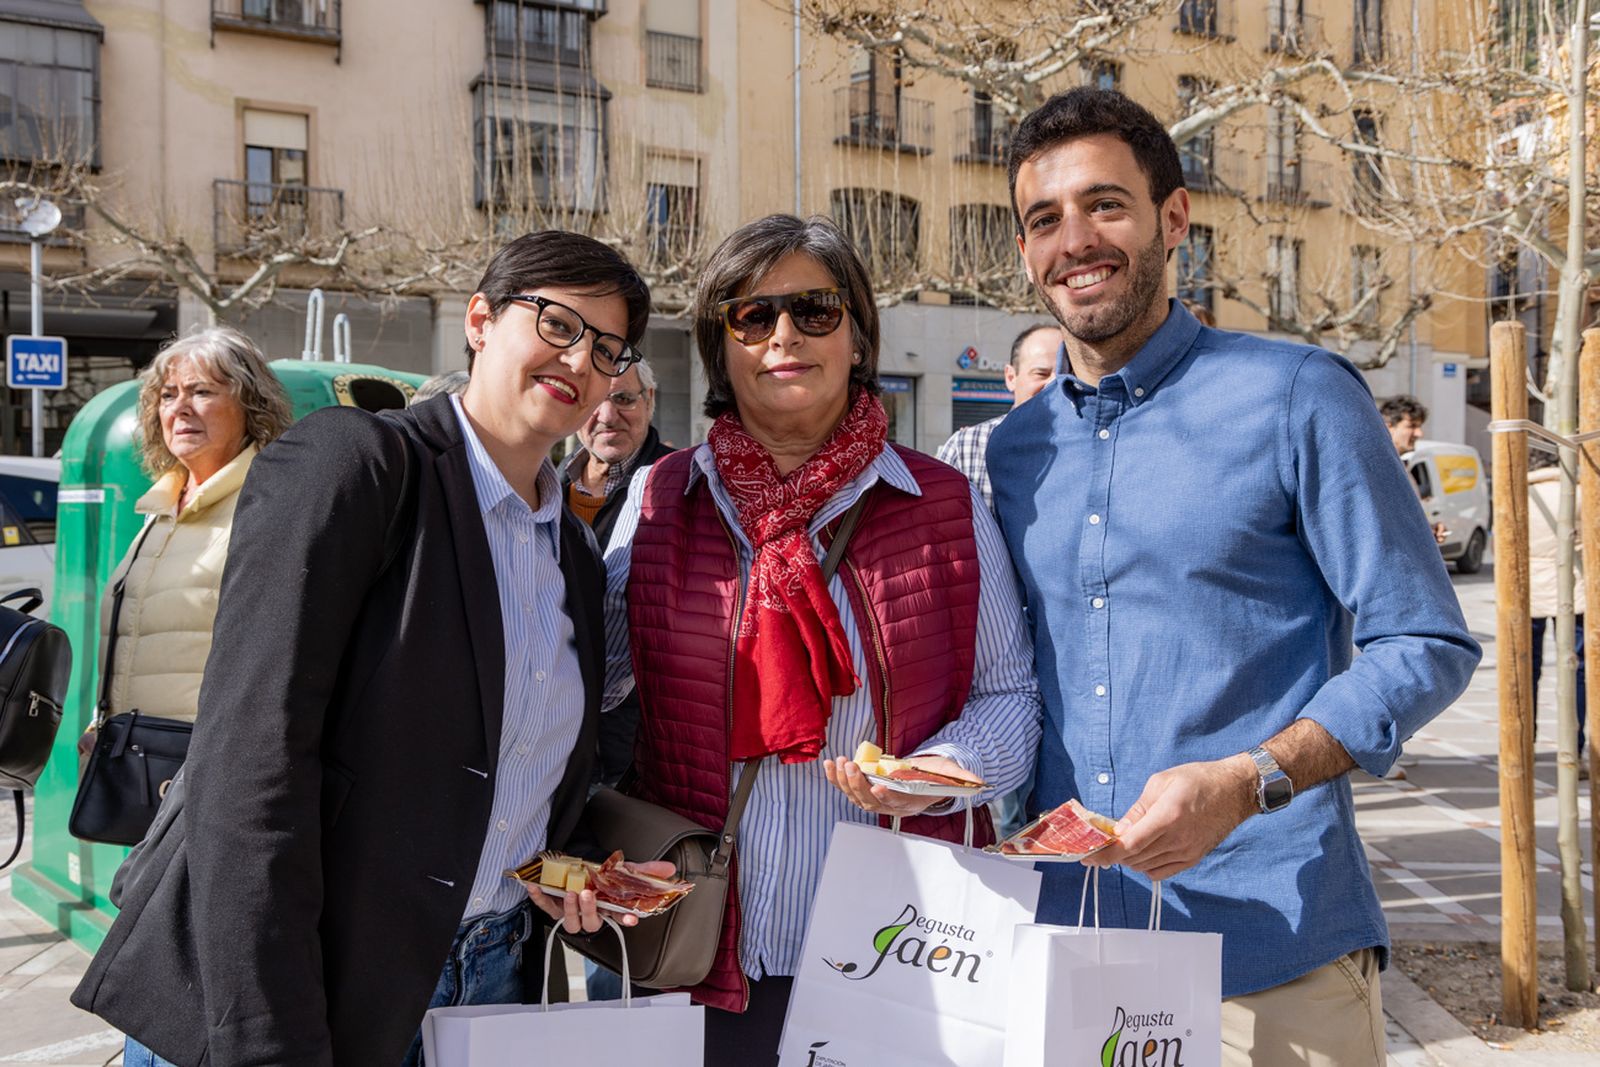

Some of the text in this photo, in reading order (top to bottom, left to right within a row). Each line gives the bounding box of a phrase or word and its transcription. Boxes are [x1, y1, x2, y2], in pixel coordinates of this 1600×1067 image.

[15, 353, 60, 373] TAXI
[892, 904, 976, 942] Degusta
[842, 925, 982, 983] Jaén
[1110, 1006, 1174, 1032] Degusta
